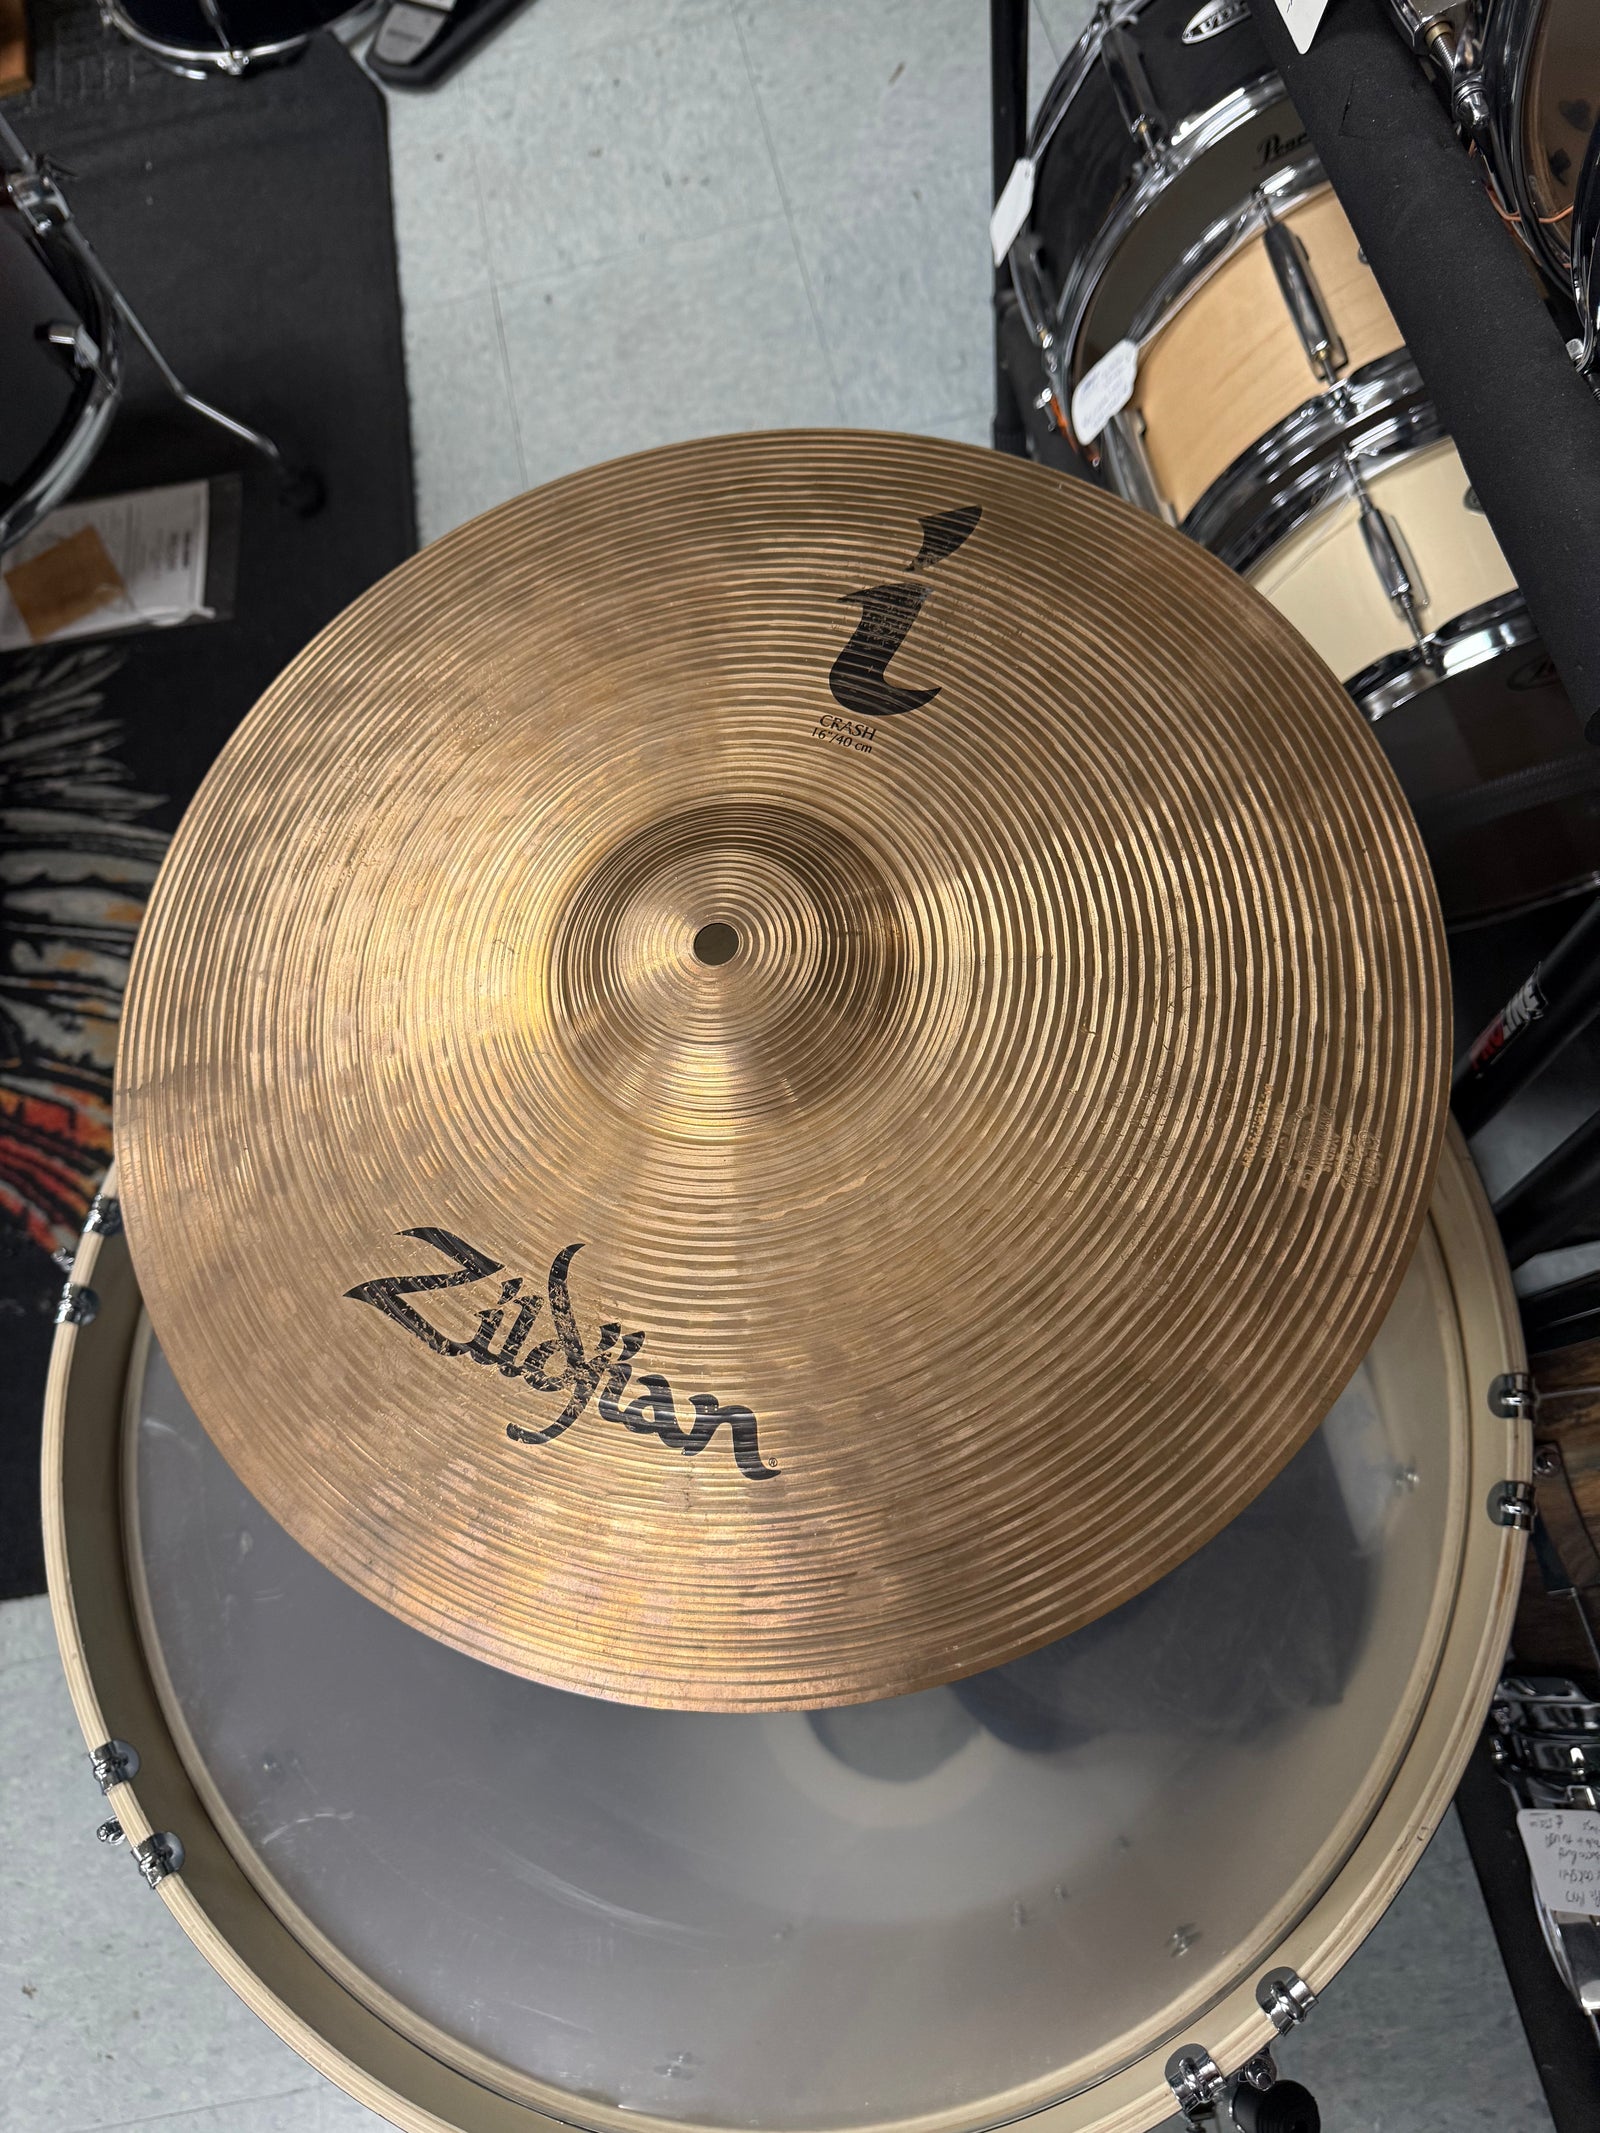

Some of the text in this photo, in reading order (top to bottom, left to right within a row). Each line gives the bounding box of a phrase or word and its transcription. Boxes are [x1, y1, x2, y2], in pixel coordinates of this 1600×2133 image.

[1254, 132, 1311, 171] Pear
[811, 726, 873, 754] 16"/40 cm
[819, 714, 877, 741] CRASH
[342, 1226, 782, 1481] Zildjian
